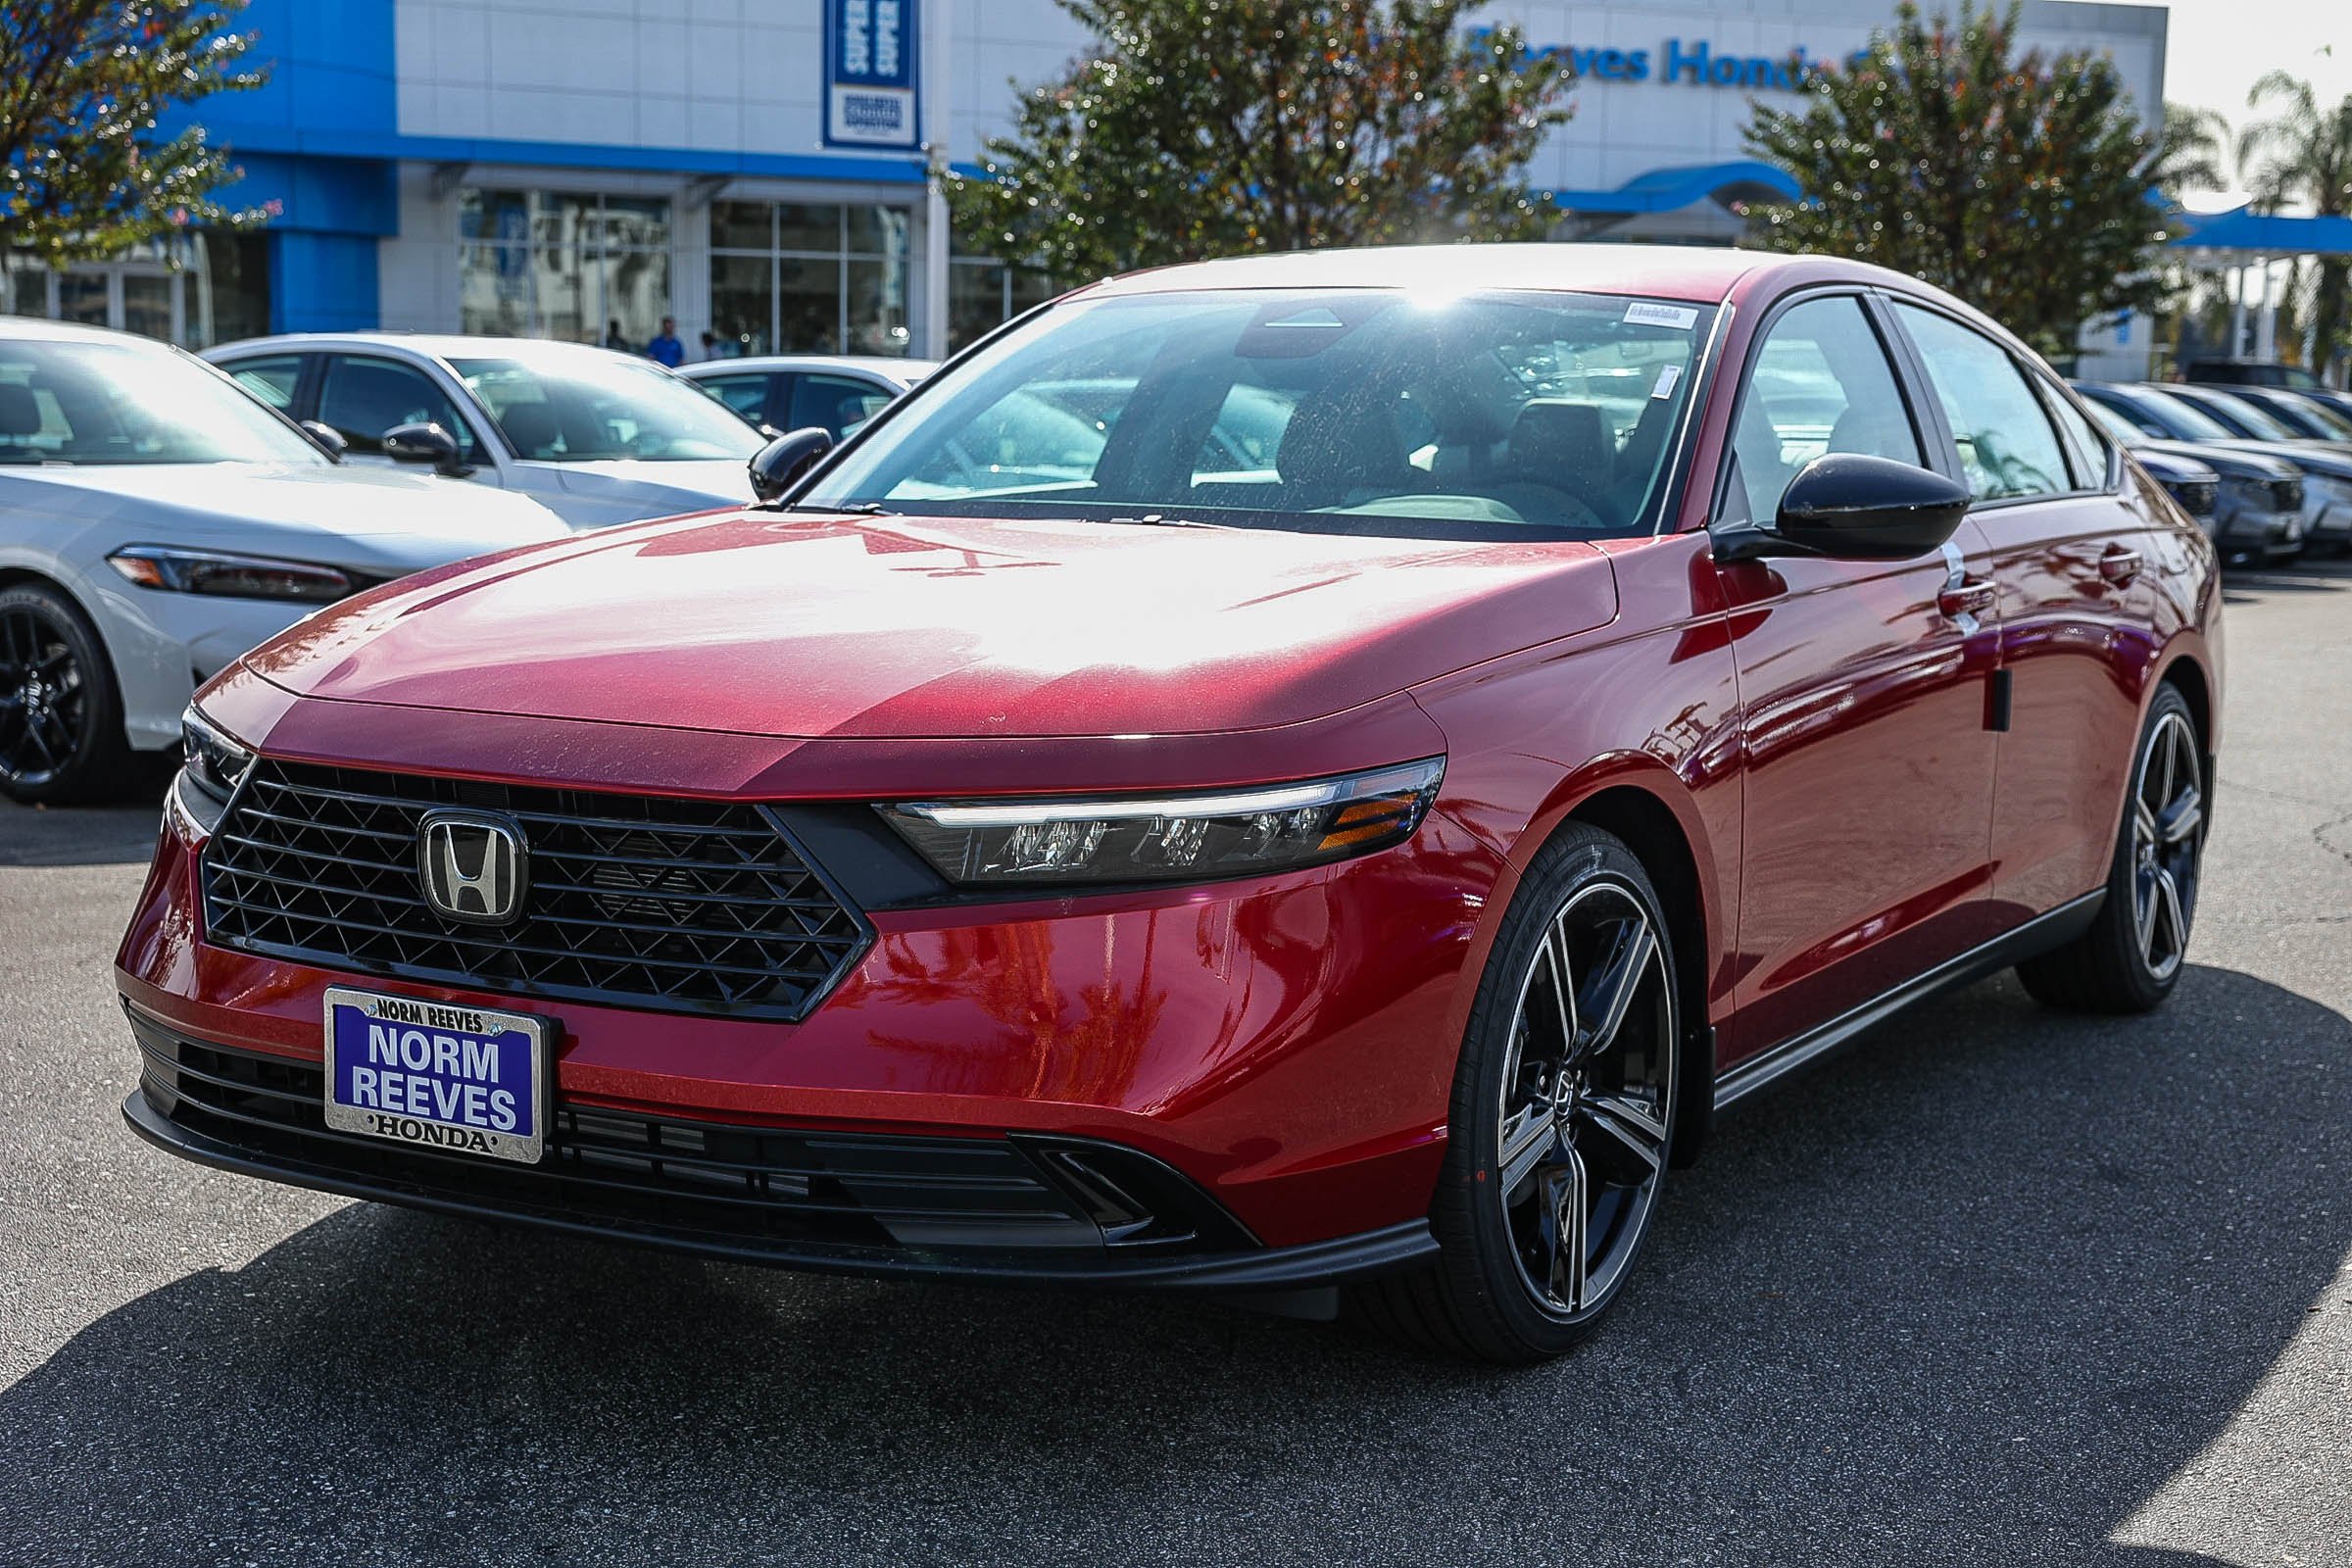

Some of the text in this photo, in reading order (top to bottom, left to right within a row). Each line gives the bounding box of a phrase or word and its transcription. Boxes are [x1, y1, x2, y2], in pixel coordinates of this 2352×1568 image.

[1665, 37, 1829, 91] Hond
[377, 999, 483, 1033] NORM REEVES
[369, 1024, 499, 1084] NORM
[353, 1065, 516, 1131] REEVES
[375, 1114, 493, 1153] HONDA
